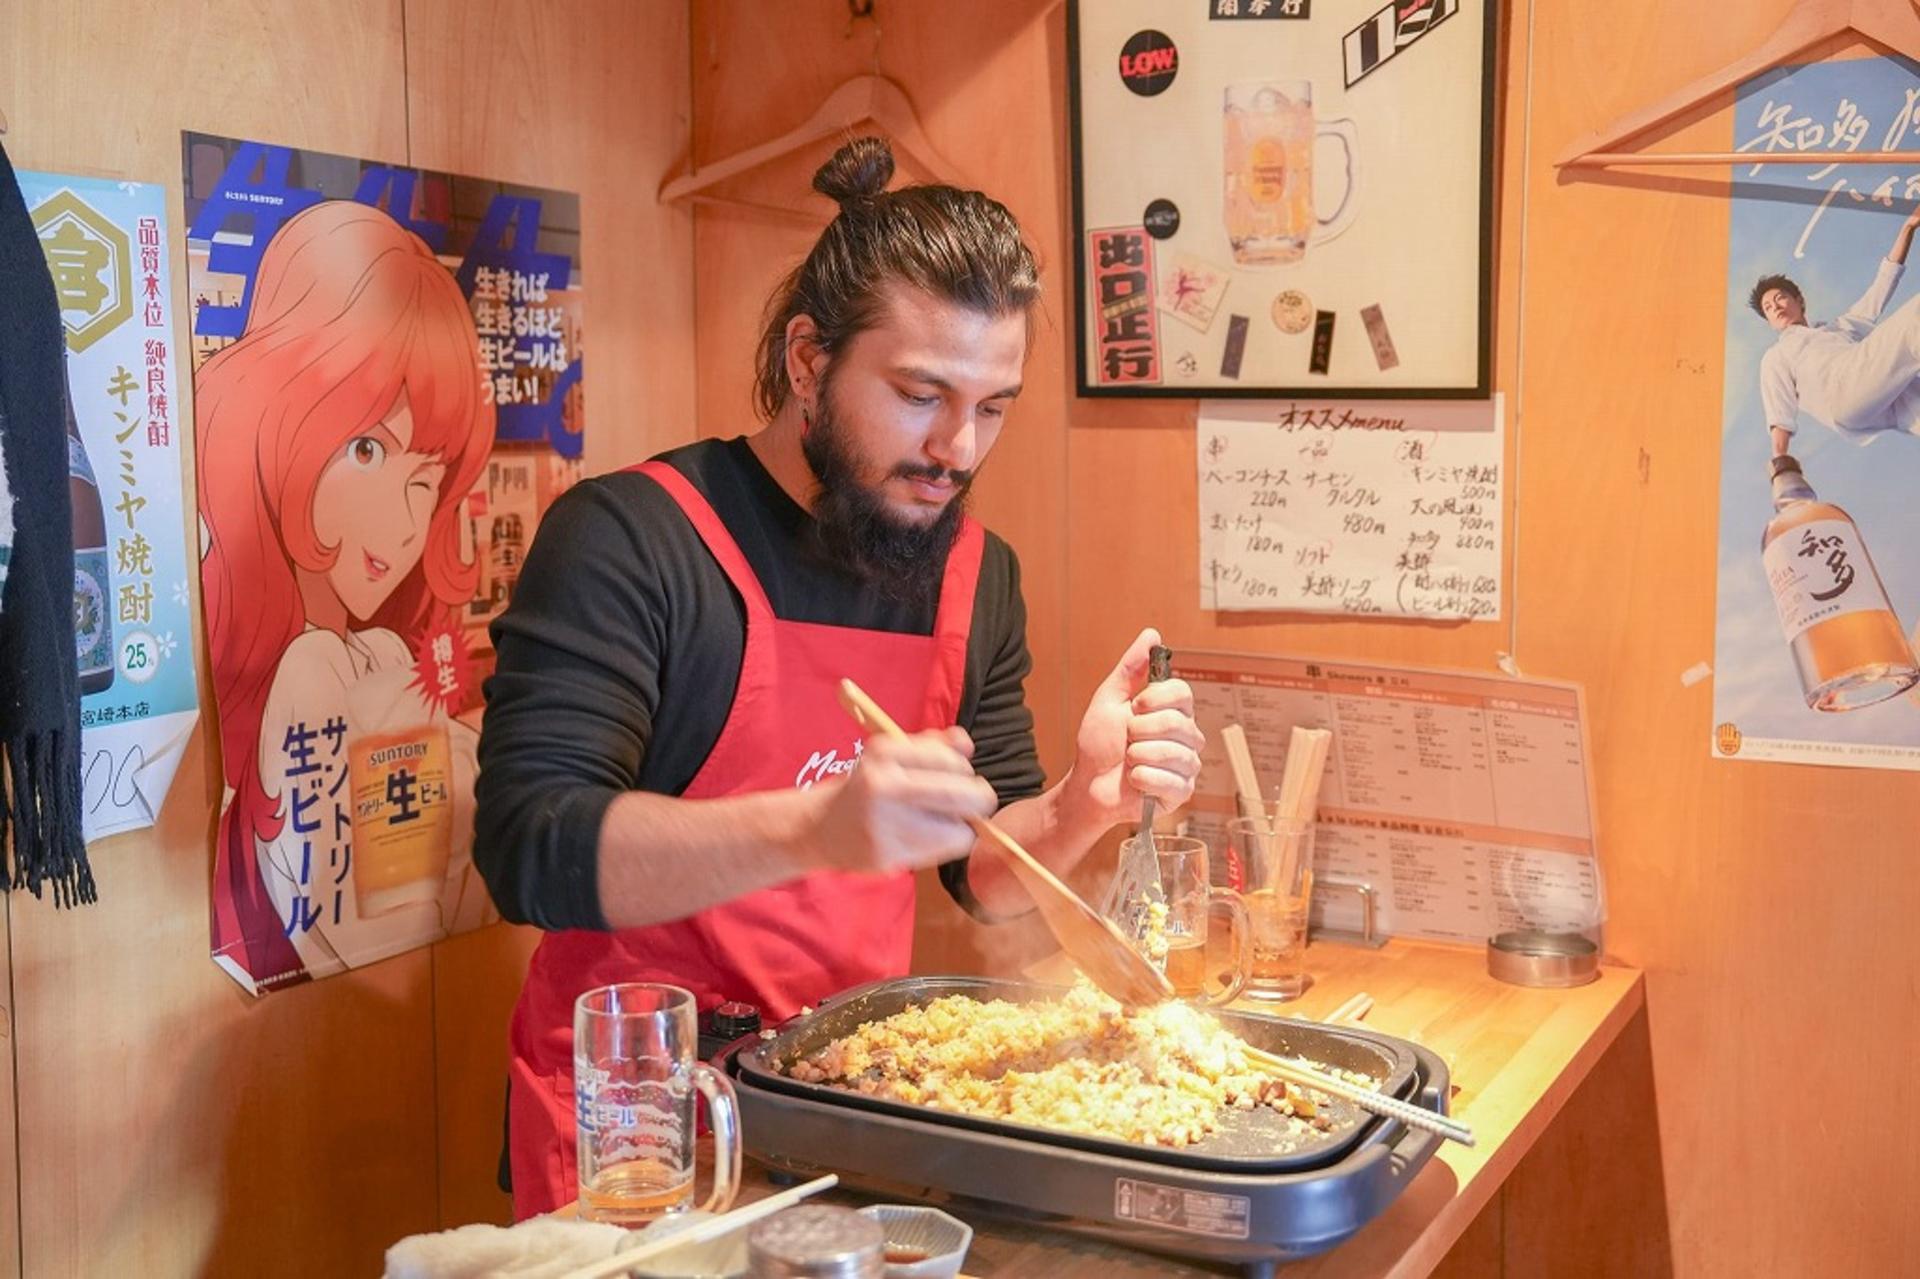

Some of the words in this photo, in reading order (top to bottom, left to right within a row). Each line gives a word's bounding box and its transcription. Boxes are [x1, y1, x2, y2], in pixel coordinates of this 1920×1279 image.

[1120, 46, 1176, 77] LOW
[138, 218, 164, 327] 品質本位
[475, 266, 549, 303] 生きれば
[476, 302, 564, 338] 生きるほど
[478, 337, 569, 373] 生ビールは
[107, 365, 154, 624] キンミヤ焼酎
[126, 643, 147, 670] 25
[369, 742, 428, 767] SUNTORY
[386, 768, 420, 825] 生
[281, 720, 323, 938] 生ビール
[320, 716, 352, 925] サントリー
